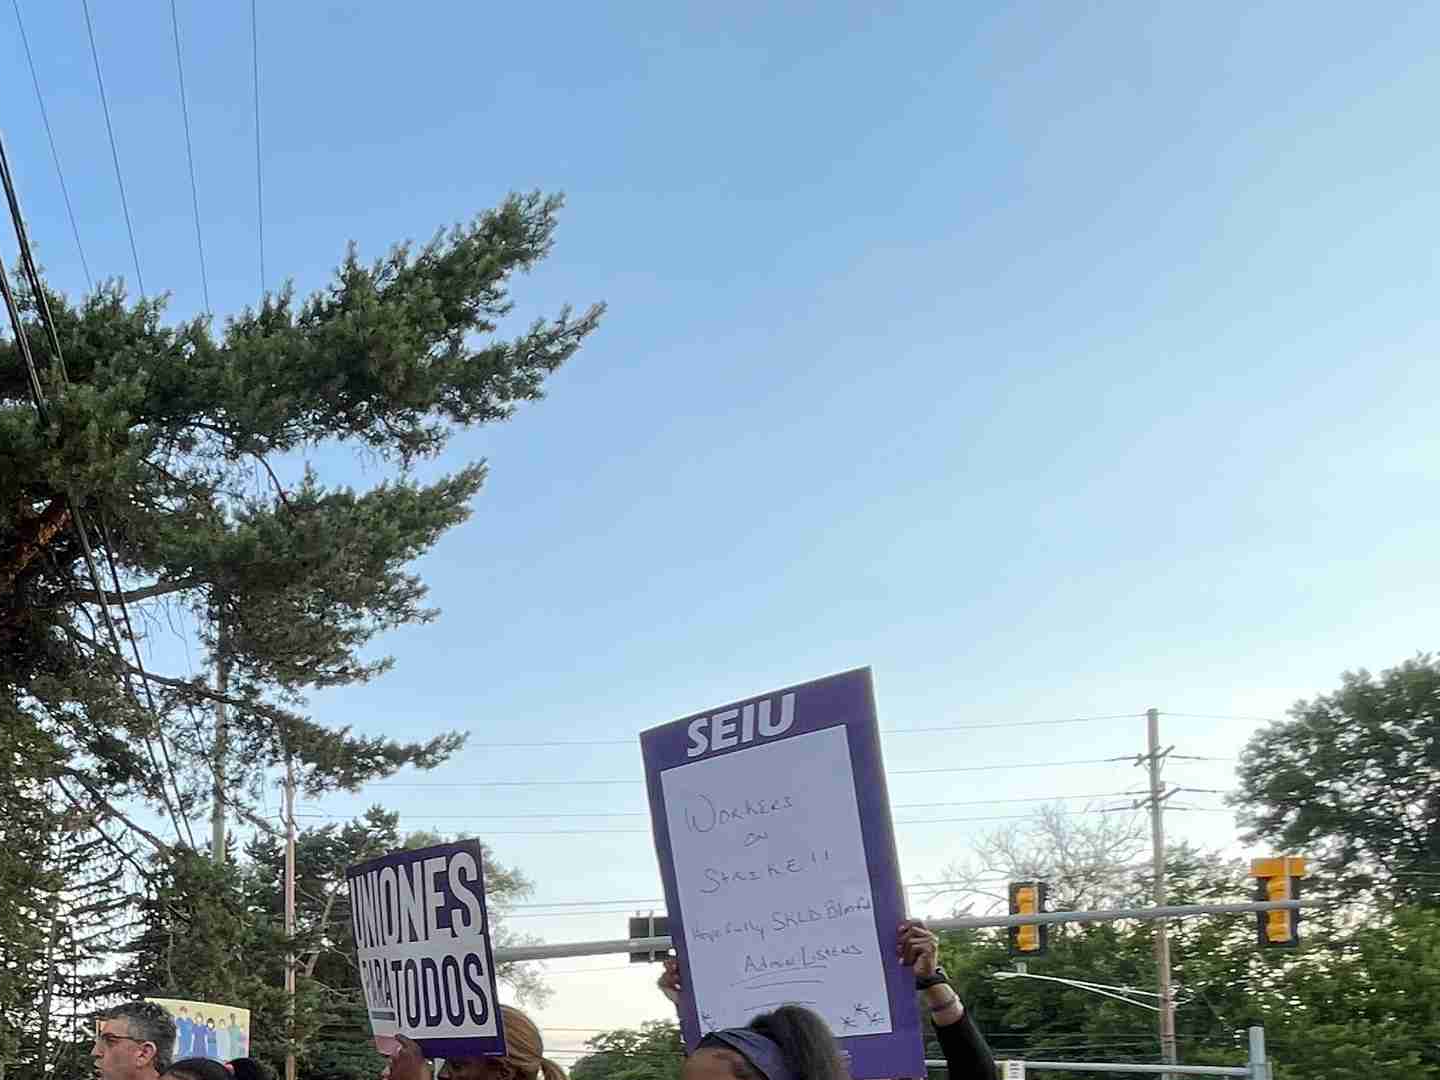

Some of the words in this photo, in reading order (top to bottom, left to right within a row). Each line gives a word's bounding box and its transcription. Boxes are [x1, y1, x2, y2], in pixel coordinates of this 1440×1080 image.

[687, 692, 796, 757] SEIU
[349, 852, 483, 949] UNIONES
[392, 953, 489, 1029] TODOS
